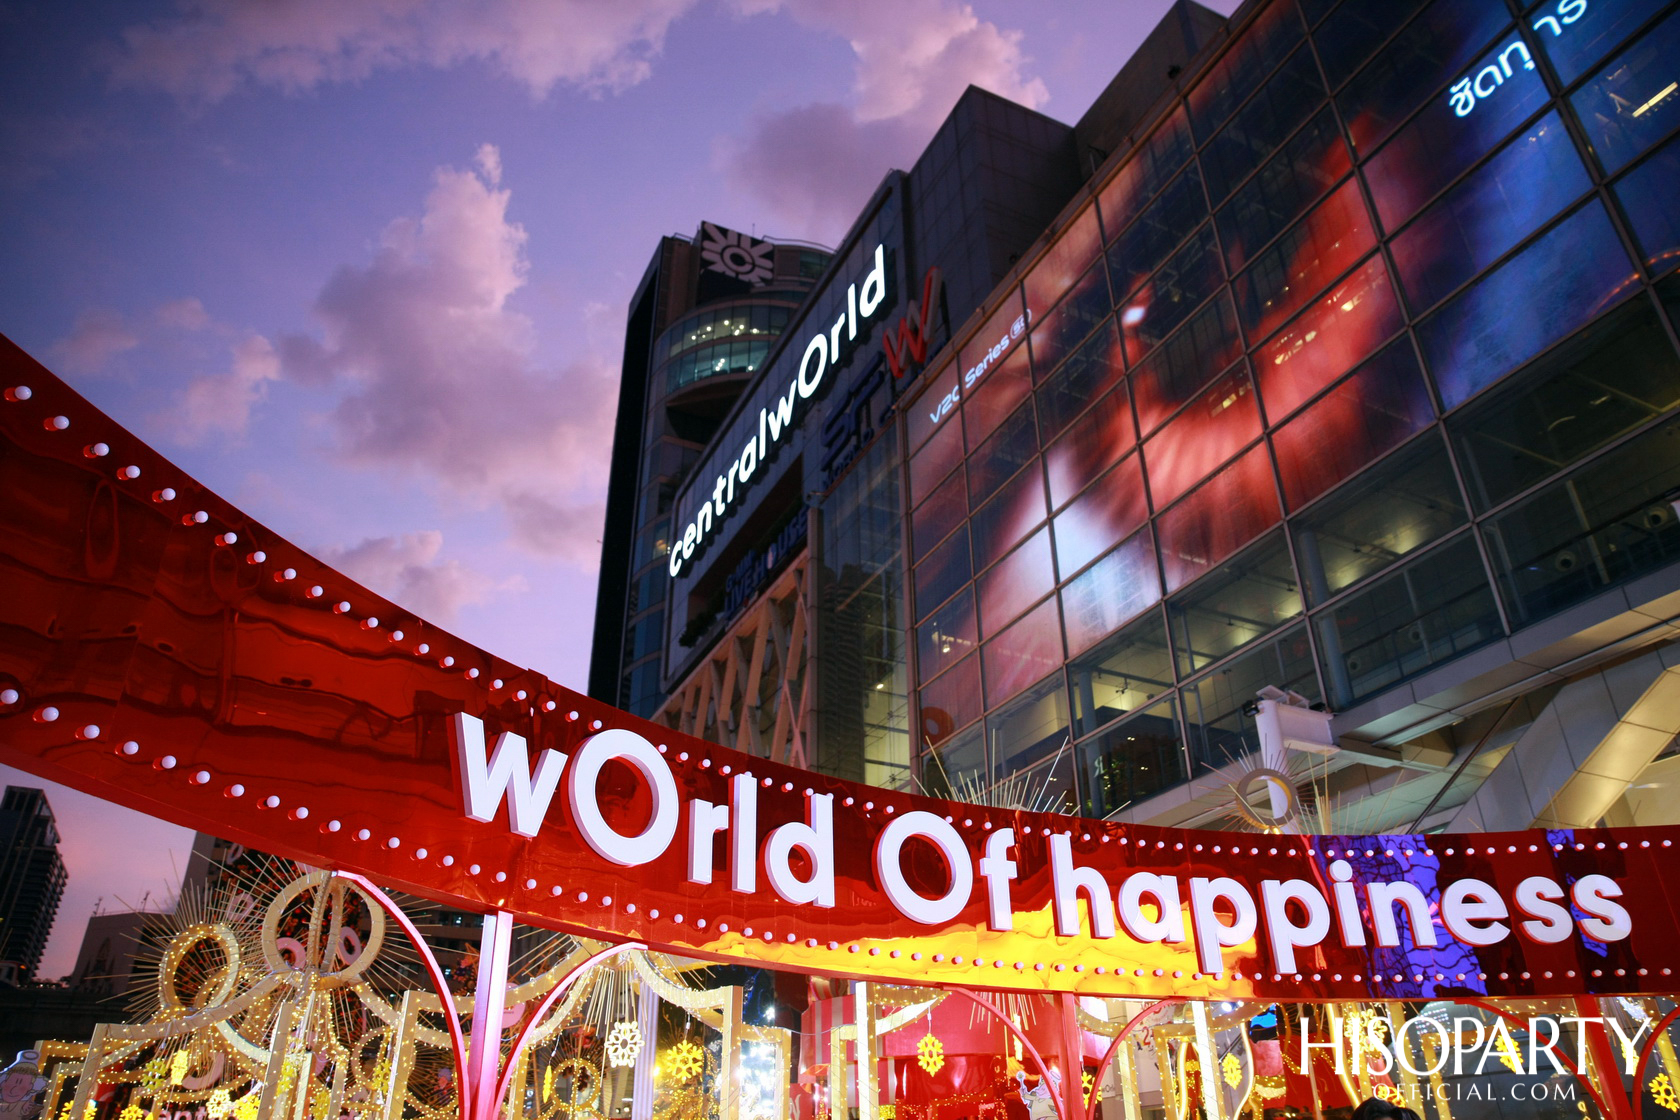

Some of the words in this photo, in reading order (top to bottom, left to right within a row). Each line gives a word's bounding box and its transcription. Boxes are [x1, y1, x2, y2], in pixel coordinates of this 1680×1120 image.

[667, 244, 886, 578] centralwOrld
[964, 334, 1010, 389] Series
[452, 711, 836, 909] wOrld
[876, 811, 1018, 931] Of
[1048, 833, 1632, 974] happiness
